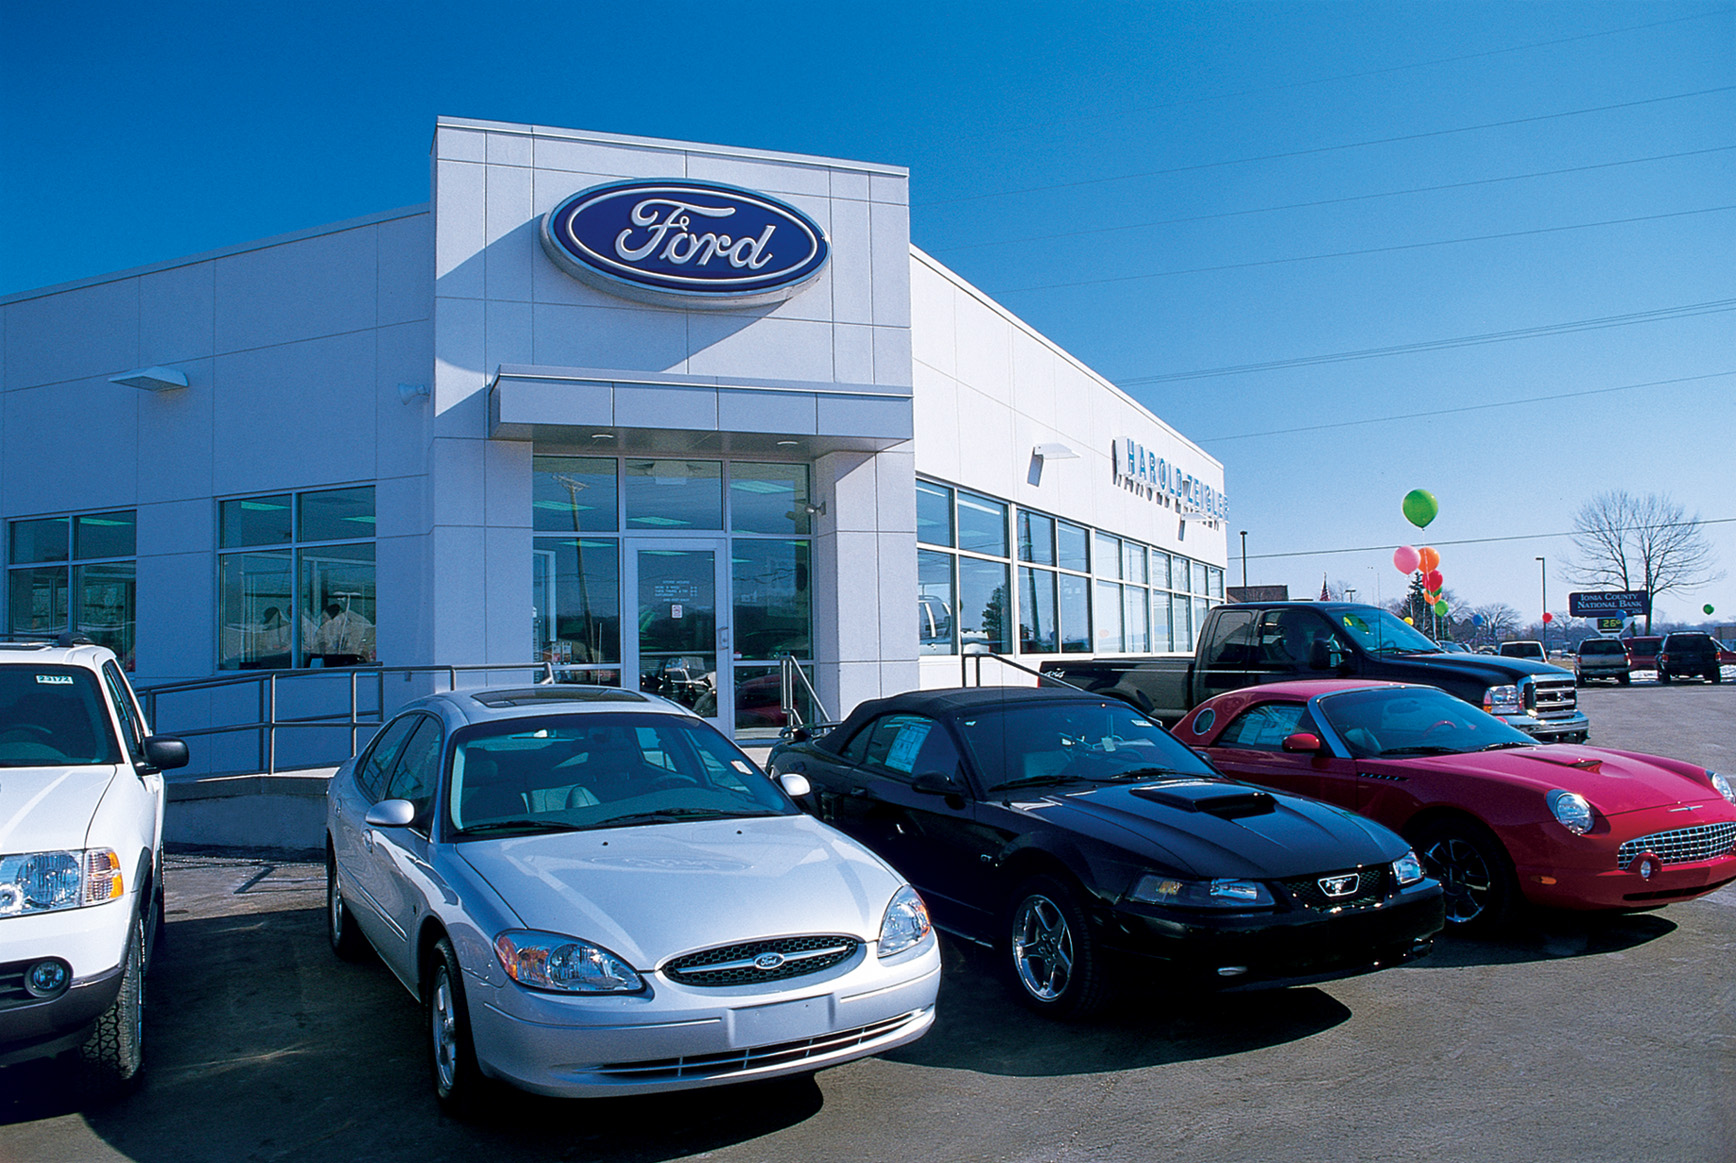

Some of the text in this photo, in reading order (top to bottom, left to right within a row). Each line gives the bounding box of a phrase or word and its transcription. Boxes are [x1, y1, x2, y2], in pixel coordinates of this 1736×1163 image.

[614, 198, 776, 270] Ford
[1125, 437, 1182, 498] HAROLD
[1577, 599, 1642, 609] NATIONAL BANK
[1580, 592, 1638, 601] IONIA COUNTY
